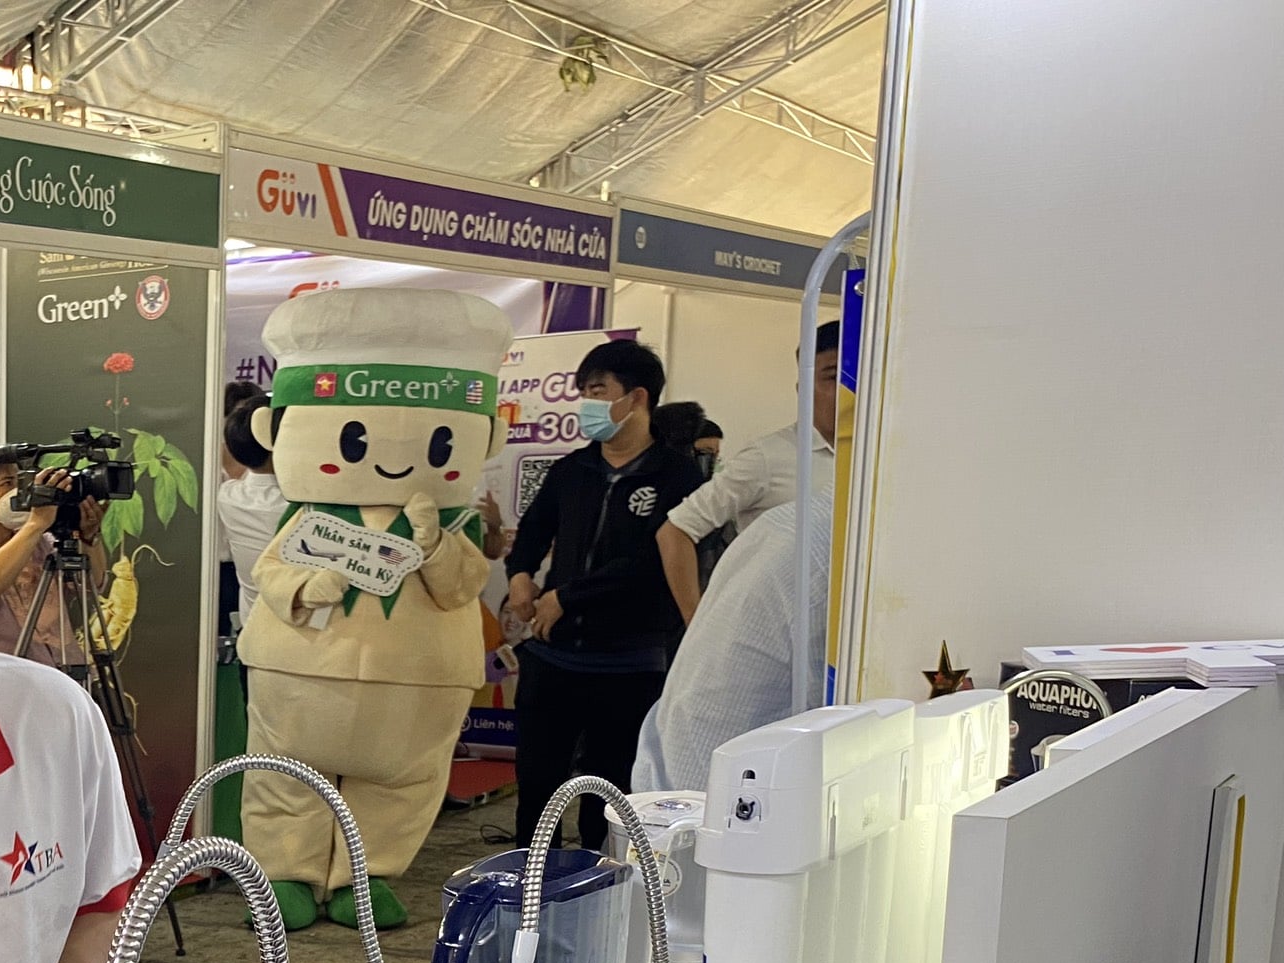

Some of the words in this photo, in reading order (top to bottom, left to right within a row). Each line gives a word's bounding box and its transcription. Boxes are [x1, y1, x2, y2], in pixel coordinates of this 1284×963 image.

[16, 156, 66, 209] Cuộc
[68, 165, 116, 227] Sống
[367, 190, 407, 230] ỨNG
[410, 205, 458, 241] DỤNG
[461, 213, 508, 245] CHĂM
[511, 216, 543, 250] SÓC
[545, 224, 576, 256] NHÀ
[577, 227, 606, 260] CỬA
[37, 293, 109, 324] Green
[343, 370, 441, 401] Green
[508, 378, 541, 394] APP
[312, 524, 345, 544] Nhân
[1029, 701, 1058, 713] water
[1059, 705, 1090, 719] filters
